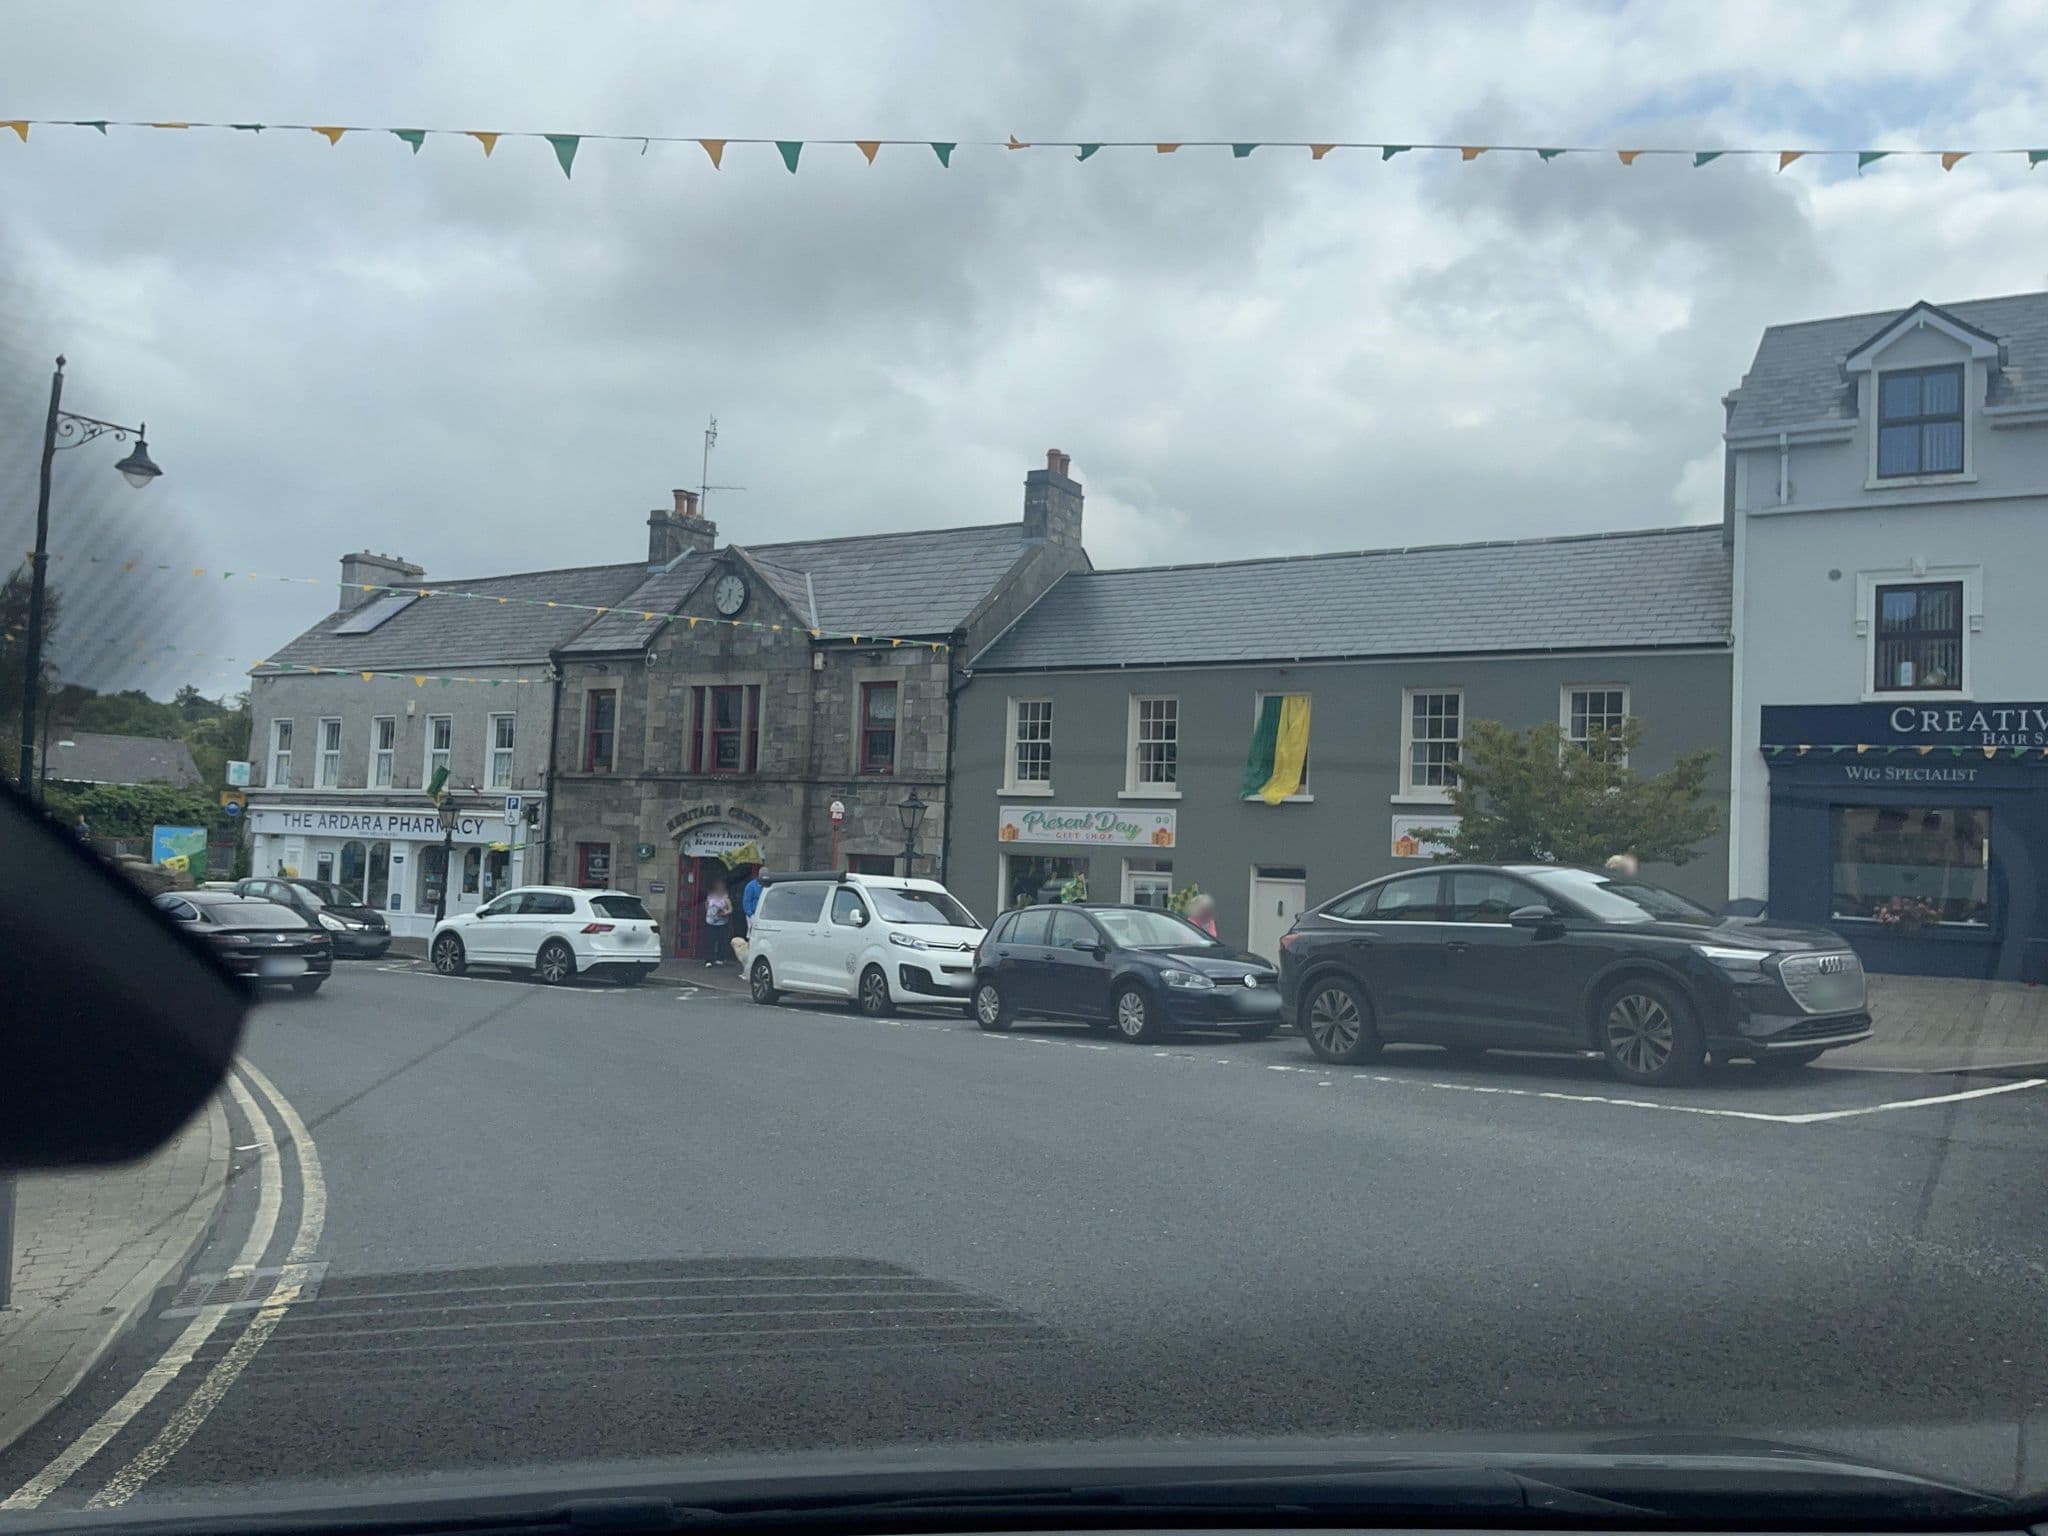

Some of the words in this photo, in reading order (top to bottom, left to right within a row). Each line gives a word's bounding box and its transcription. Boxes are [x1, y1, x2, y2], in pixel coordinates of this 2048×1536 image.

[1982, 732, 2028, 745] HAIR
[2034, 732, 2048, 745] S
[1845, 766, 1881, 780] WIG
[1885, 767, 1978, 782] SPECIALIST
[282, 812, 313, 829] THE
[318, 814, 383, 831] ARDARA
[387, 816, 485, 836] PHARMACY
[666, 804, 721, 833] HERITAGE
[1022, 810, 1094, 833] Present
[1095, 810, 1143, 840] Day
